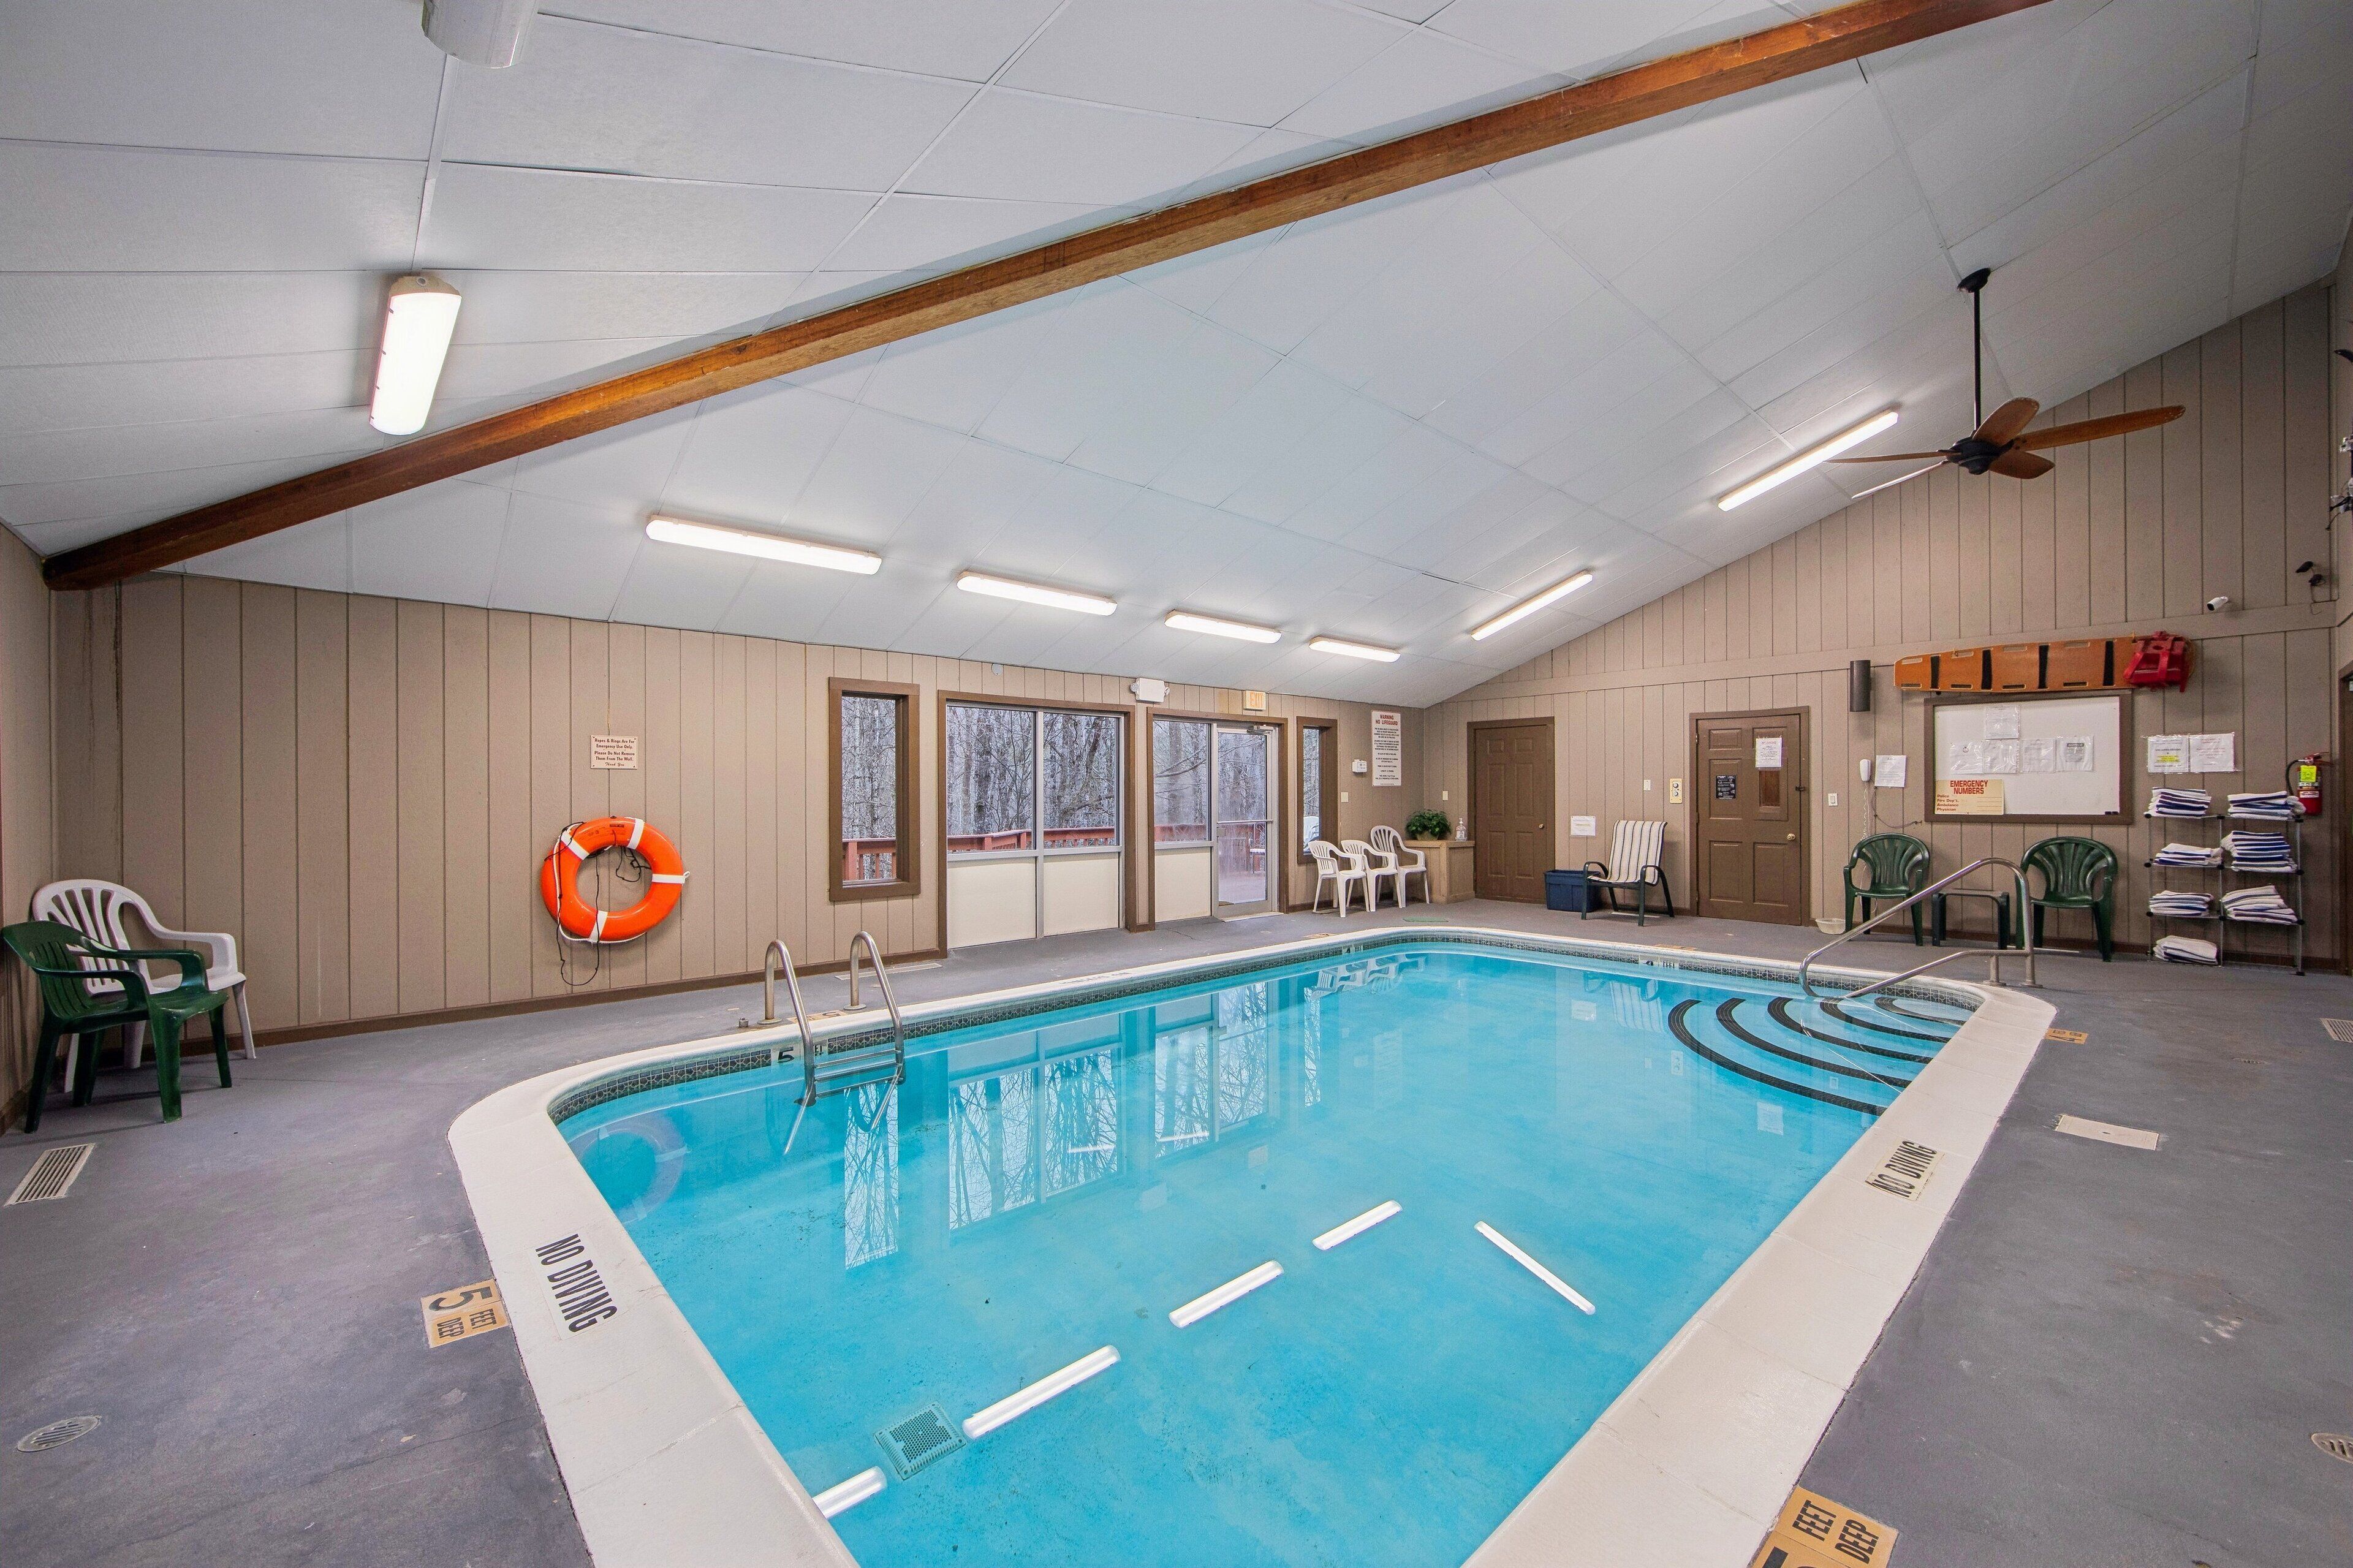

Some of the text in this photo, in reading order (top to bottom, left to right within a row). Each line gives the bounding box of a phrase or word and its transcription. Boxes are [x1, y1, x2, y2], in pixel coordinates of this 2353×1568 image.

[1250, 691, 1263, 708] EXIT
[777, 1046, 795, 1063] 5
[1865, 1140, 1938, 1198] NO DIVING
[536, 1233, 618, 1333] NO DIVING
[429, 1286, 493, 1311] 5
[437, 1317, 465, 1339] DEEP
[469, 1309, 497, 1330] FEET
[1792, 1499, 1836, 1542] FEET
[1834, 1519, 1879, 1564] DEEP
